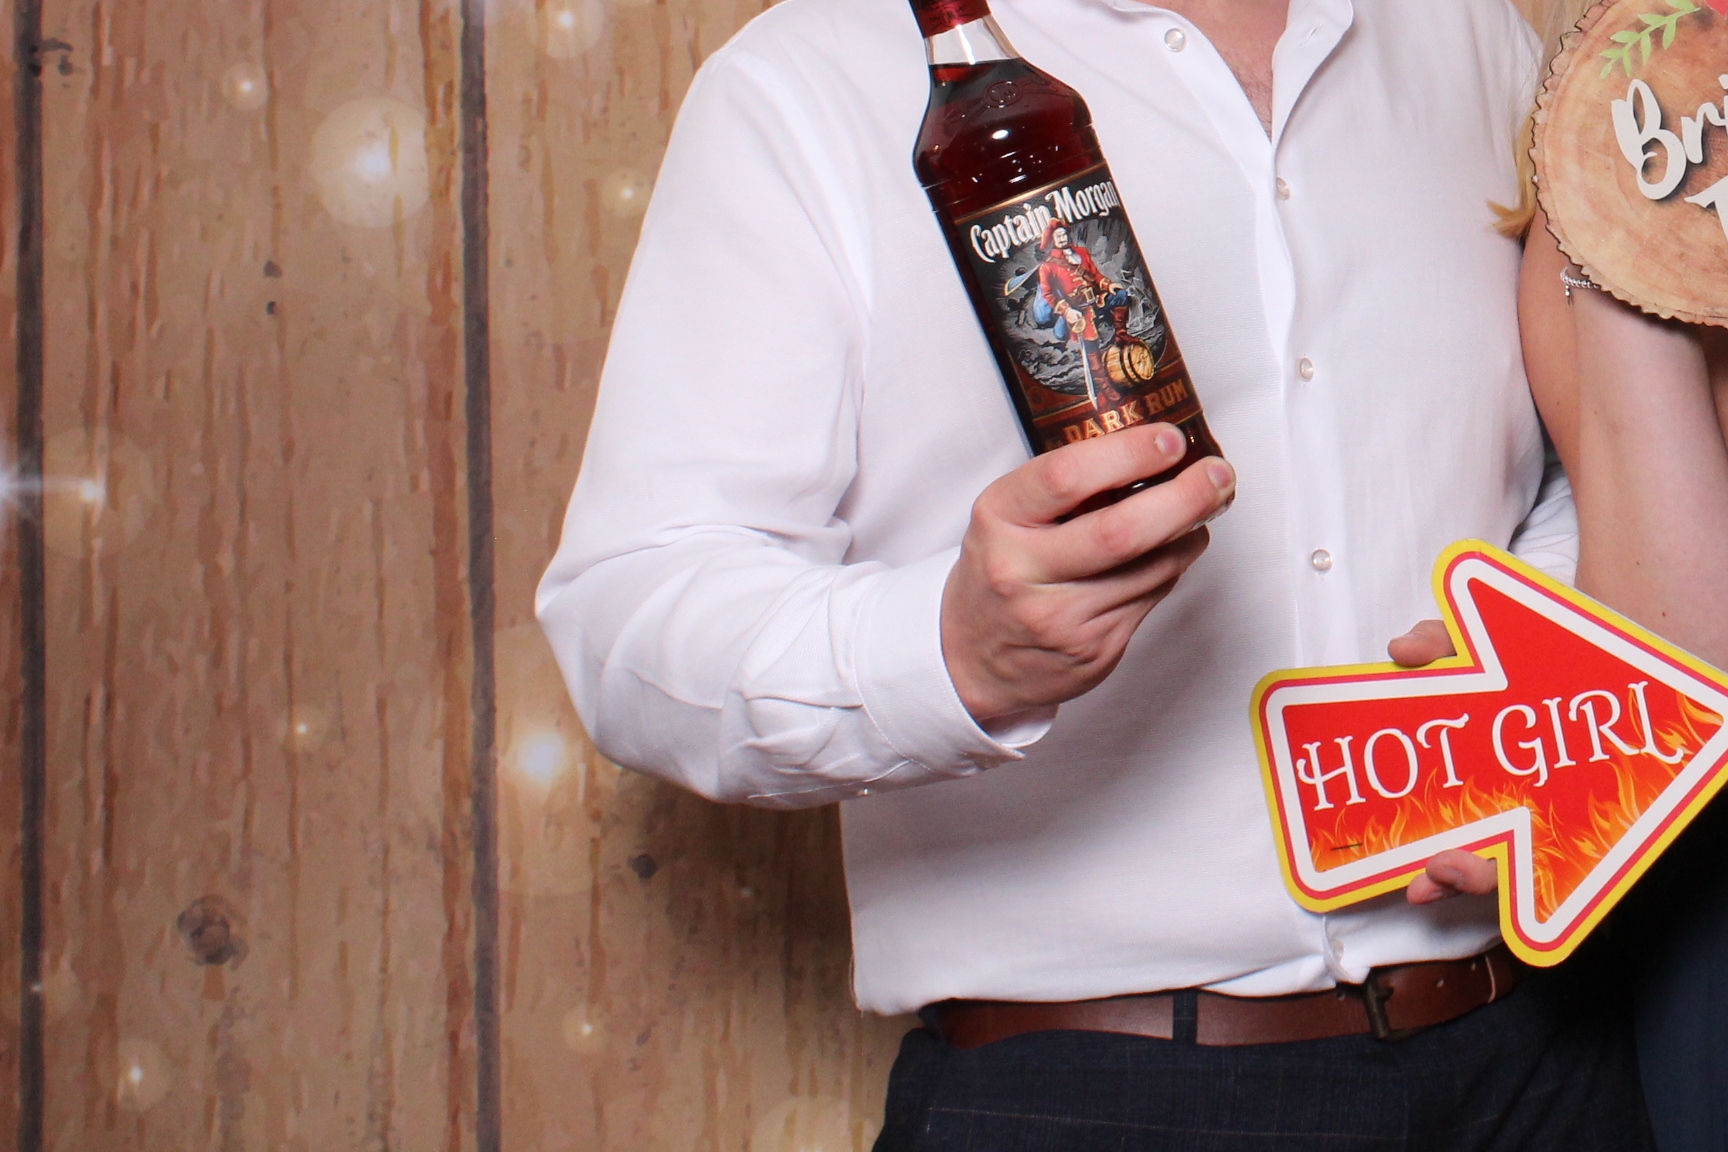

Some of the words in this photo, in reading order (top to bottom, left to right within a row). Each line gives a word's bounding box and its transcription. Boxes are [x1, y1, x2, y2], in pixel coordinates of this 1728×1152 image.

[970, 203, 1050, 263] Captain
[1045, 180, 1121, 223] Morgan
[1062, 400, 1144, 443] DARK
[1146, 379, 1189, 414] RUM
[1296, 713, 1470, 812] HOT
[1491, 680, 1684, 788] GIRL
